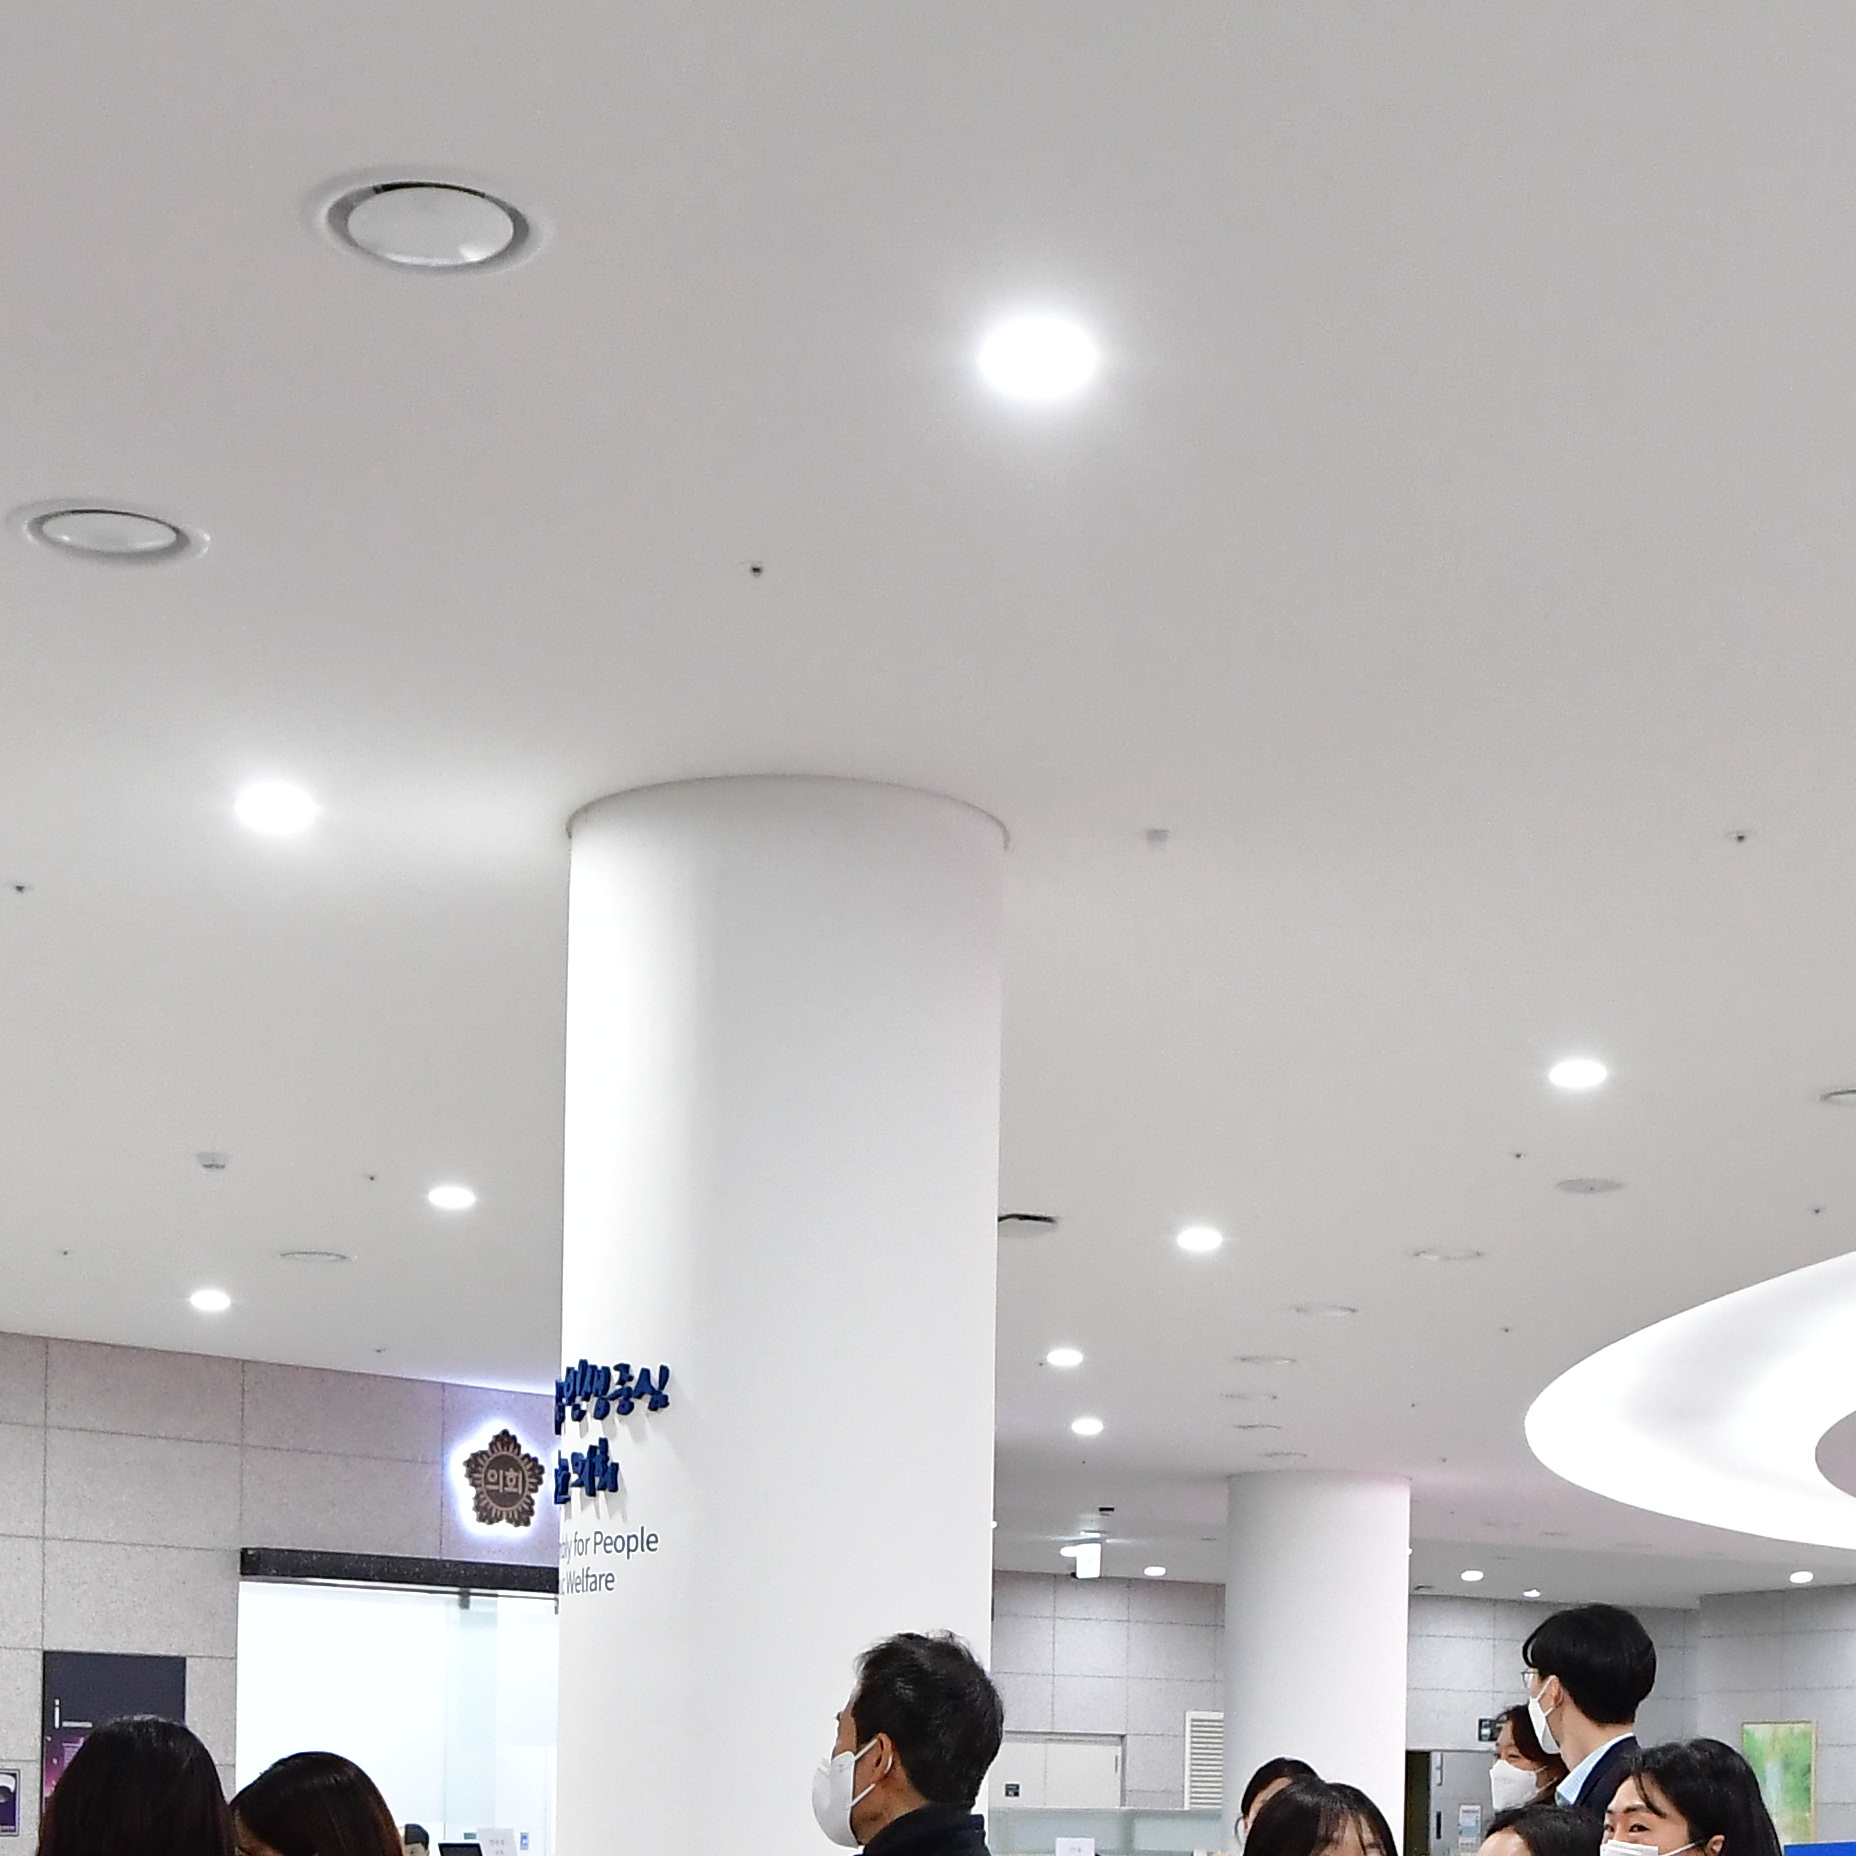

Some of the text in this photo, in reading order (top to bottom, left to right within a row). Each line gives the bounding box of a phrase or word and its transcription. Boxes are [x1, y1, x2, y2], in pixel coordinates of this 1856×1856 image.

[485, 1467, 523, 1495] 의회
[574, 1531, 591, 1557] for
[593, 1526, 659, 1560] People
[566, 1566, 615, 1594] Welfare
